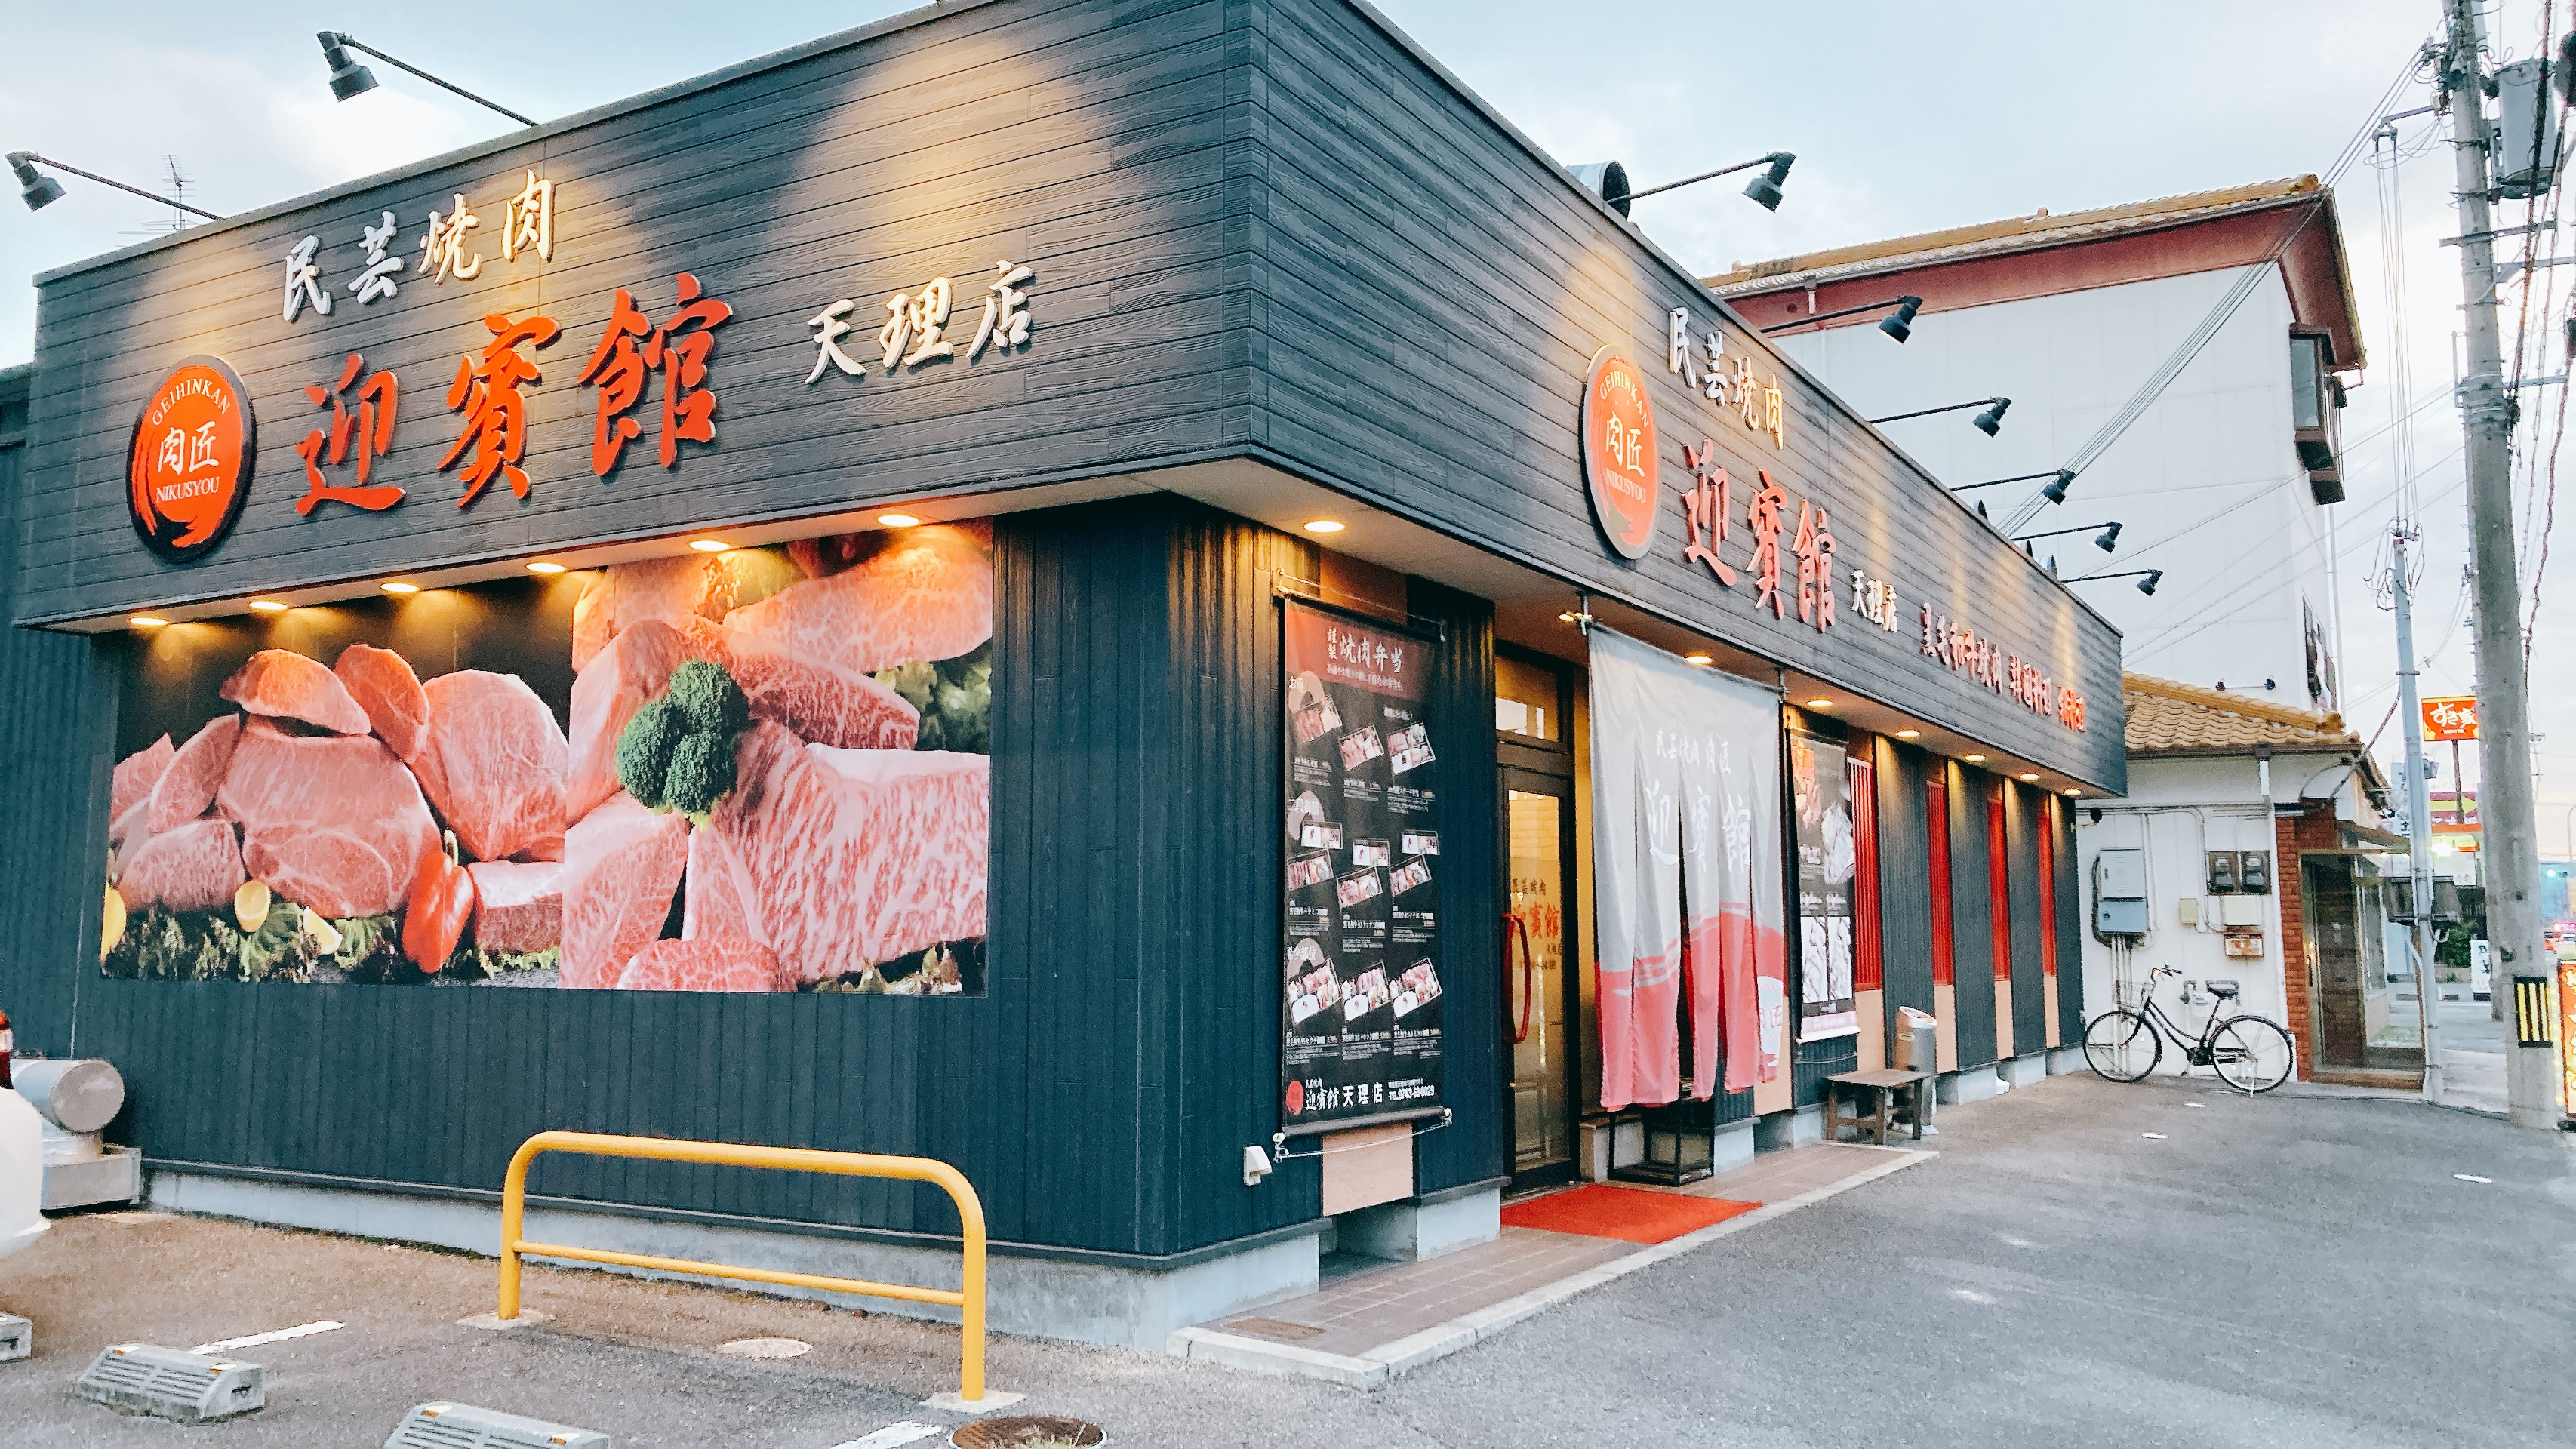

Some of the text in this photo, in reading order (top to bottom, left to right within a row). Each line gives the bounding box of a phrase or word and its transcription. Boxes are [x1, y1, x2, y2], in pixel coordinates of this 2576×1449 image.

[280, 168, 556, 323] 民芸焼肉
[804, 260, 1035, 386] 天理店
[152, 377, 231, 426] GEIHINKAN
[294, 272, 734, 517] 迎賓館
[1599, 368, 1650, 429] GEIHINKAN
[1669, 306, 1784, 451] 民芸焼肉
[158, 420, 220, 475] 肉匠
[1605, 410, 1645, 478] 肉匠
[155, 476, 220, 503] NIKUSYOU
[1605, 466, 1648, 504] NIKUSYOU
[1680, 438, 1838, 633] 迎賓館
[1339, 632, 1402, 673] 焼肉弁当
[2429, 702, 2477, 729] すき家
[1656, 728, 1732, 775] 民芸焼肉 肉匠
[1645, 778, 1750, 874] 迎賓館
[1343, 1082, 1383, 1108] 天理店
